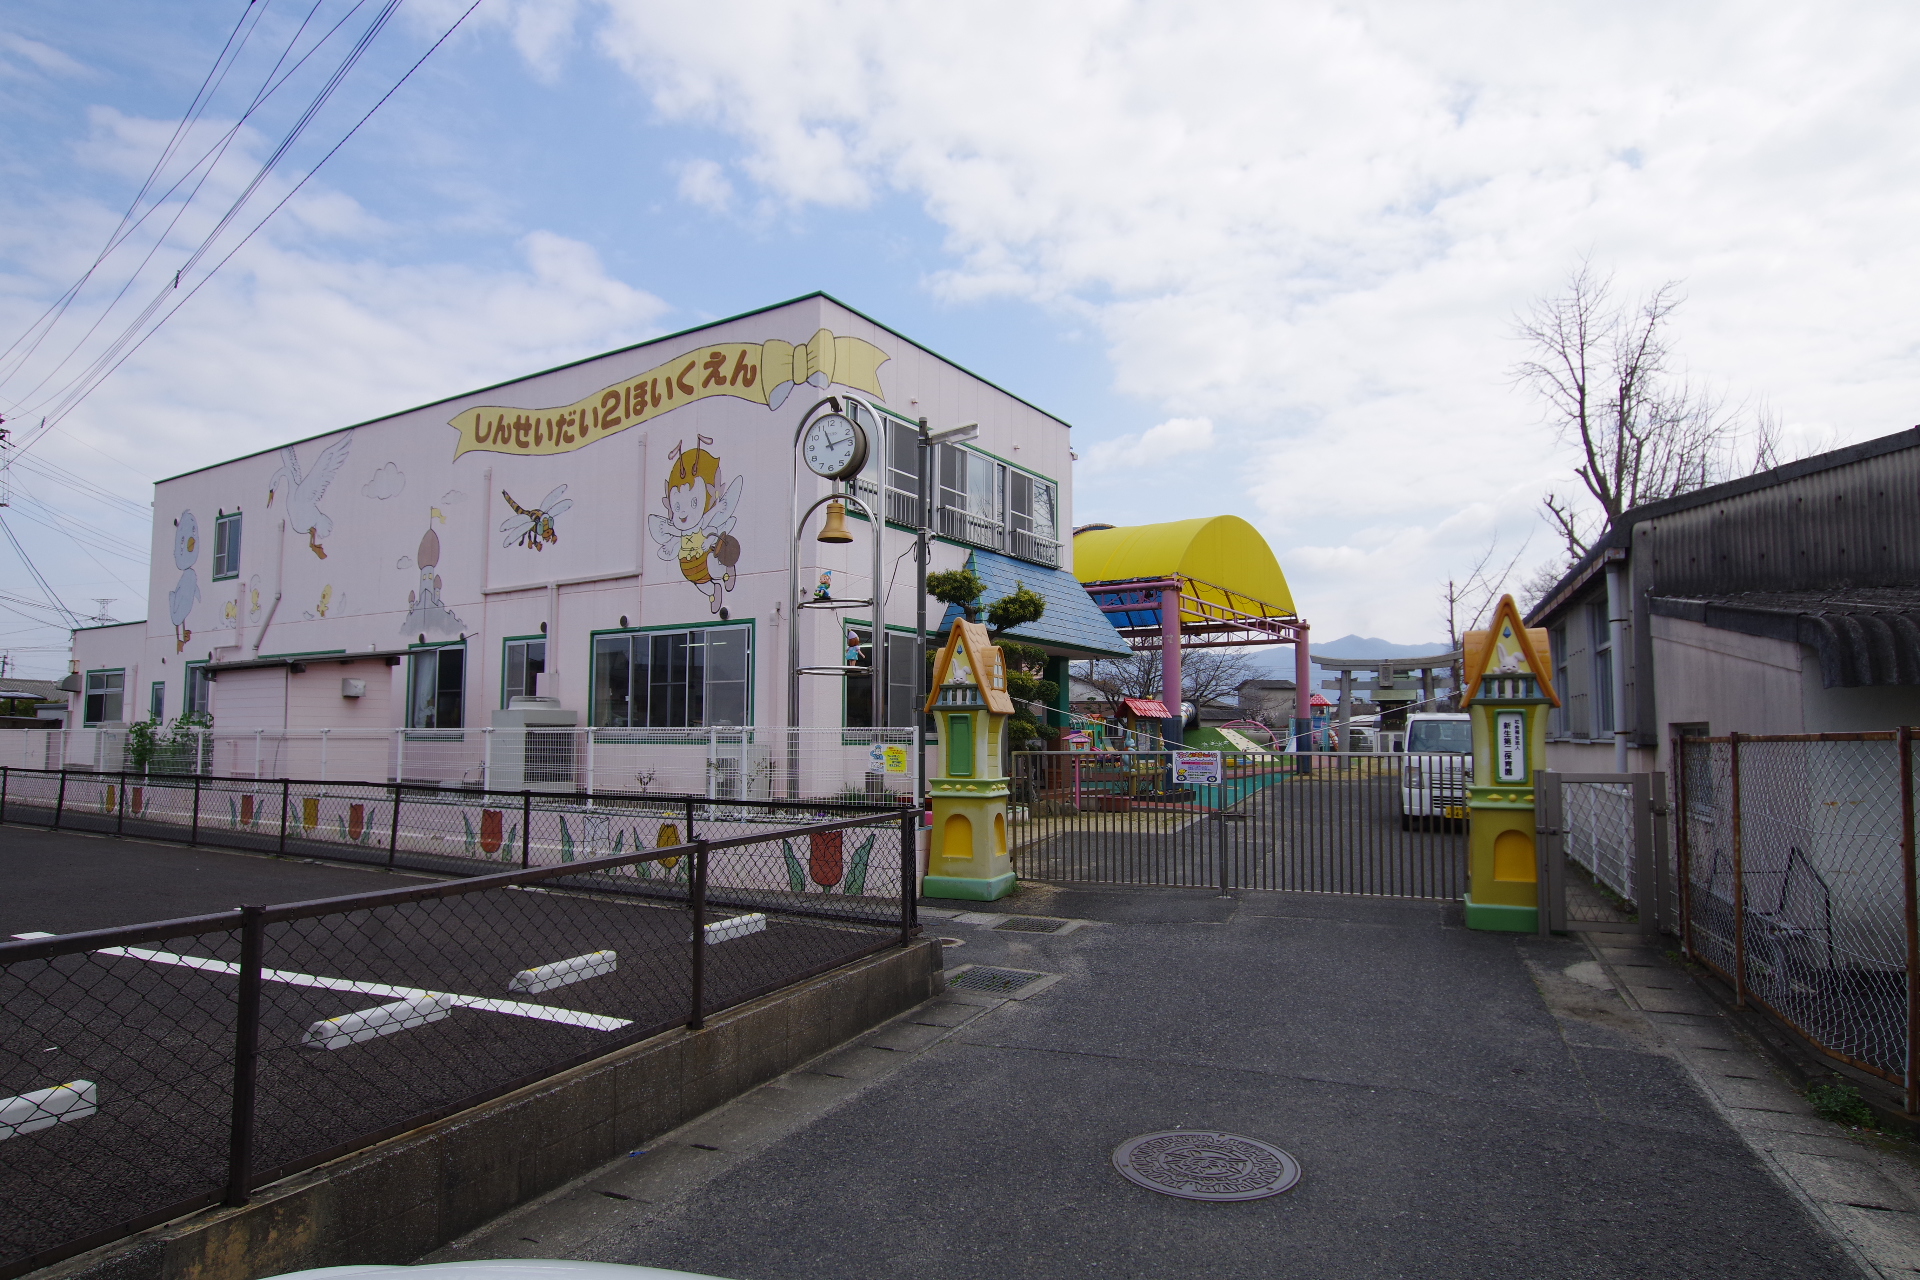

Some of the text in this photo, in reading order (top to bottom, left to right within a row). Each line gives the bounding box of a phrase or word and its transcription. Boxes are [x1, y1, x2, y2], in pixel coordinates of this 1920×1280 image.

[475, 349, 757, 448] しんせいだい2ほいくえん
[1504, 722, 1512, 776] 新生第二保育園
